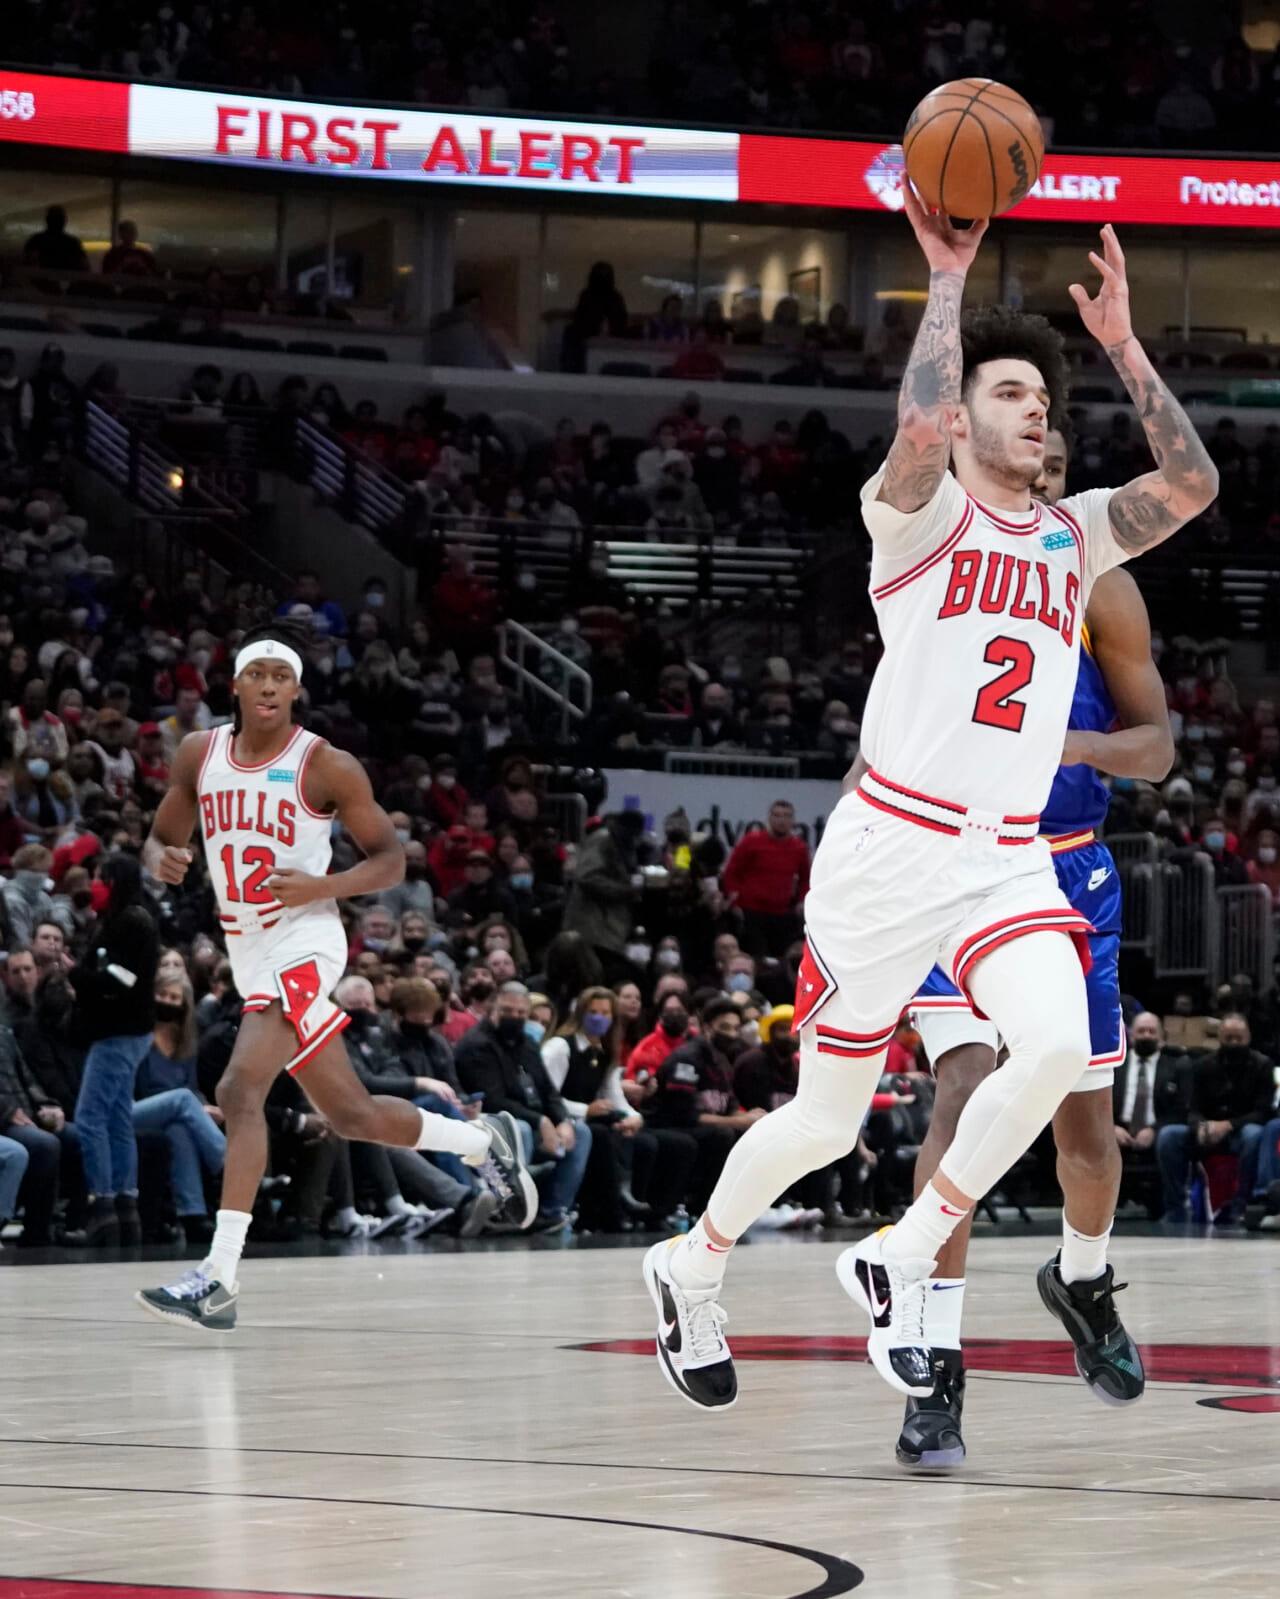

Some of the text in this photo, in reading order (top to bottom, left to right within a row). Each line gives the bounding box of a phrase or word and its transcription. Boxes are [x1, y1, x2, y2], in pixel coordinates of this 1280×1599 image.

[0, 90, 36, 120] 58
[215, 106, 646, 184] FIRST ALERT
[1027, 173, 1120, 201] ALERT
[937, 549, 1080, 648] BULLS
[971, 634, 1036, 733] 2
[200, 789, 297, 848] BULLS
[220, 843, 276, 904] 12
